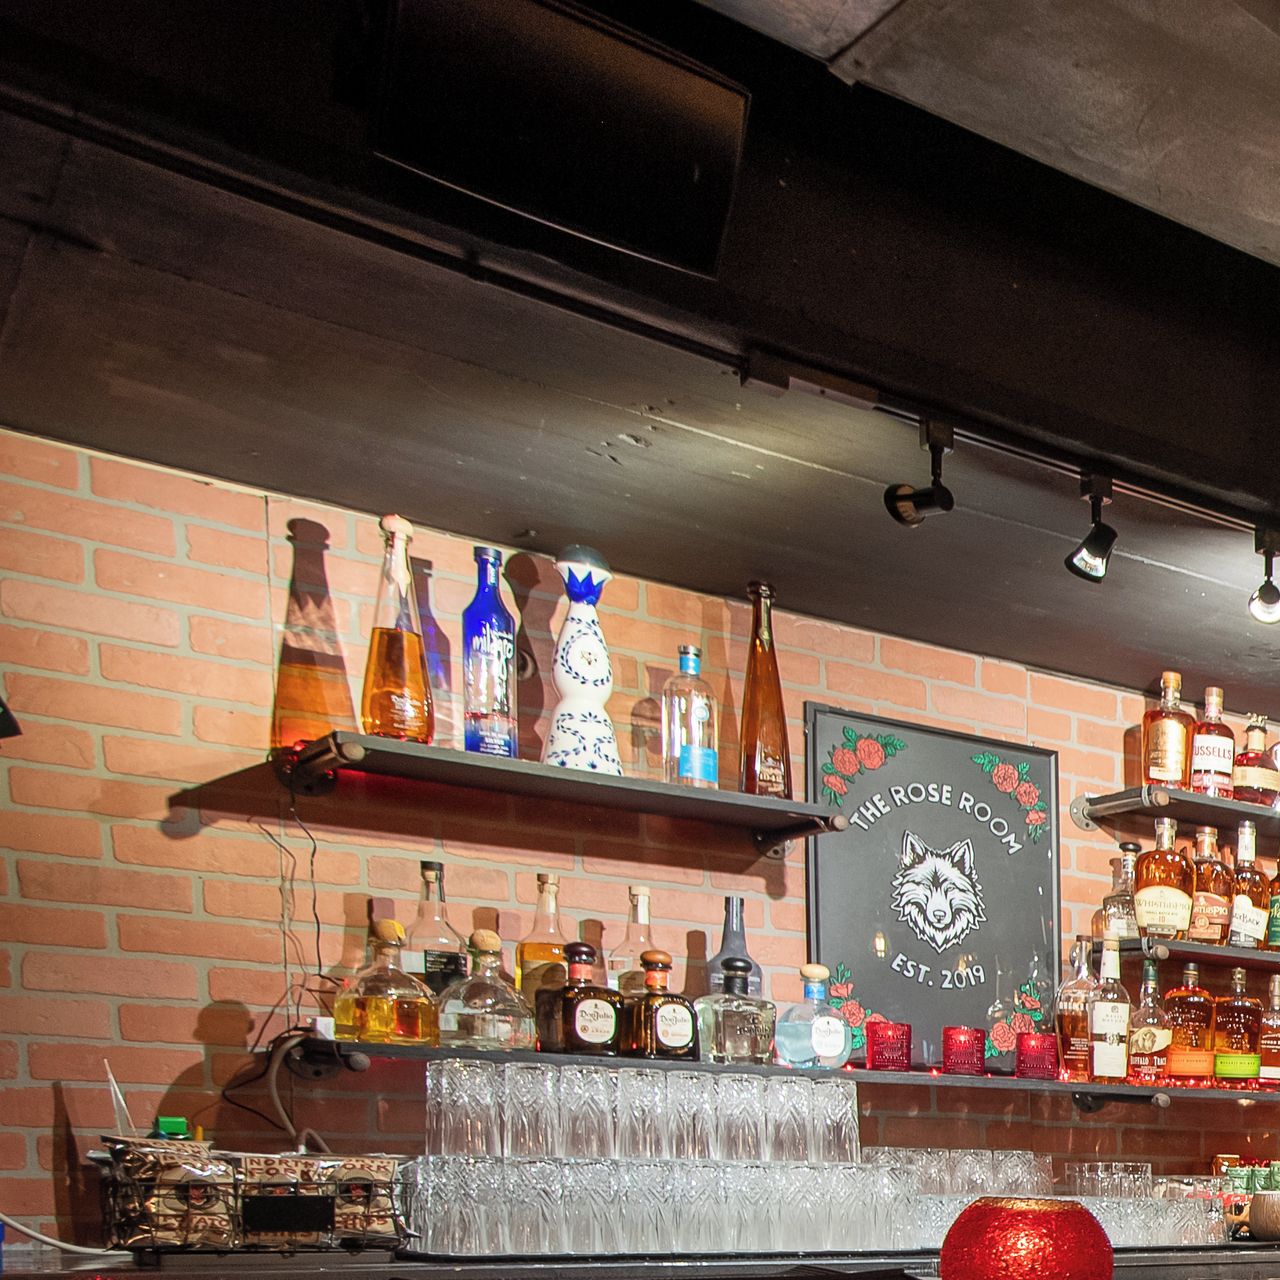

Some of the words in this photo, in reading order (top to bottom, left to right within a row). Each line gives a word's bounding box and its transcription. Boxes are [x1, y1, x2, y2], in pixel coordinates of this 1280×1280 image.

[849, 793, 891, 833] THE
[889, 782, 953, 807] ROSE
[958, 791, 1024, 855] ROOM
[890, 952, 934, 987] EST.
[941, 964, 986, 990] 2019
[247, 1167, 315, 1182] FORK
[249, 1157, 317, 1170] NORTH
